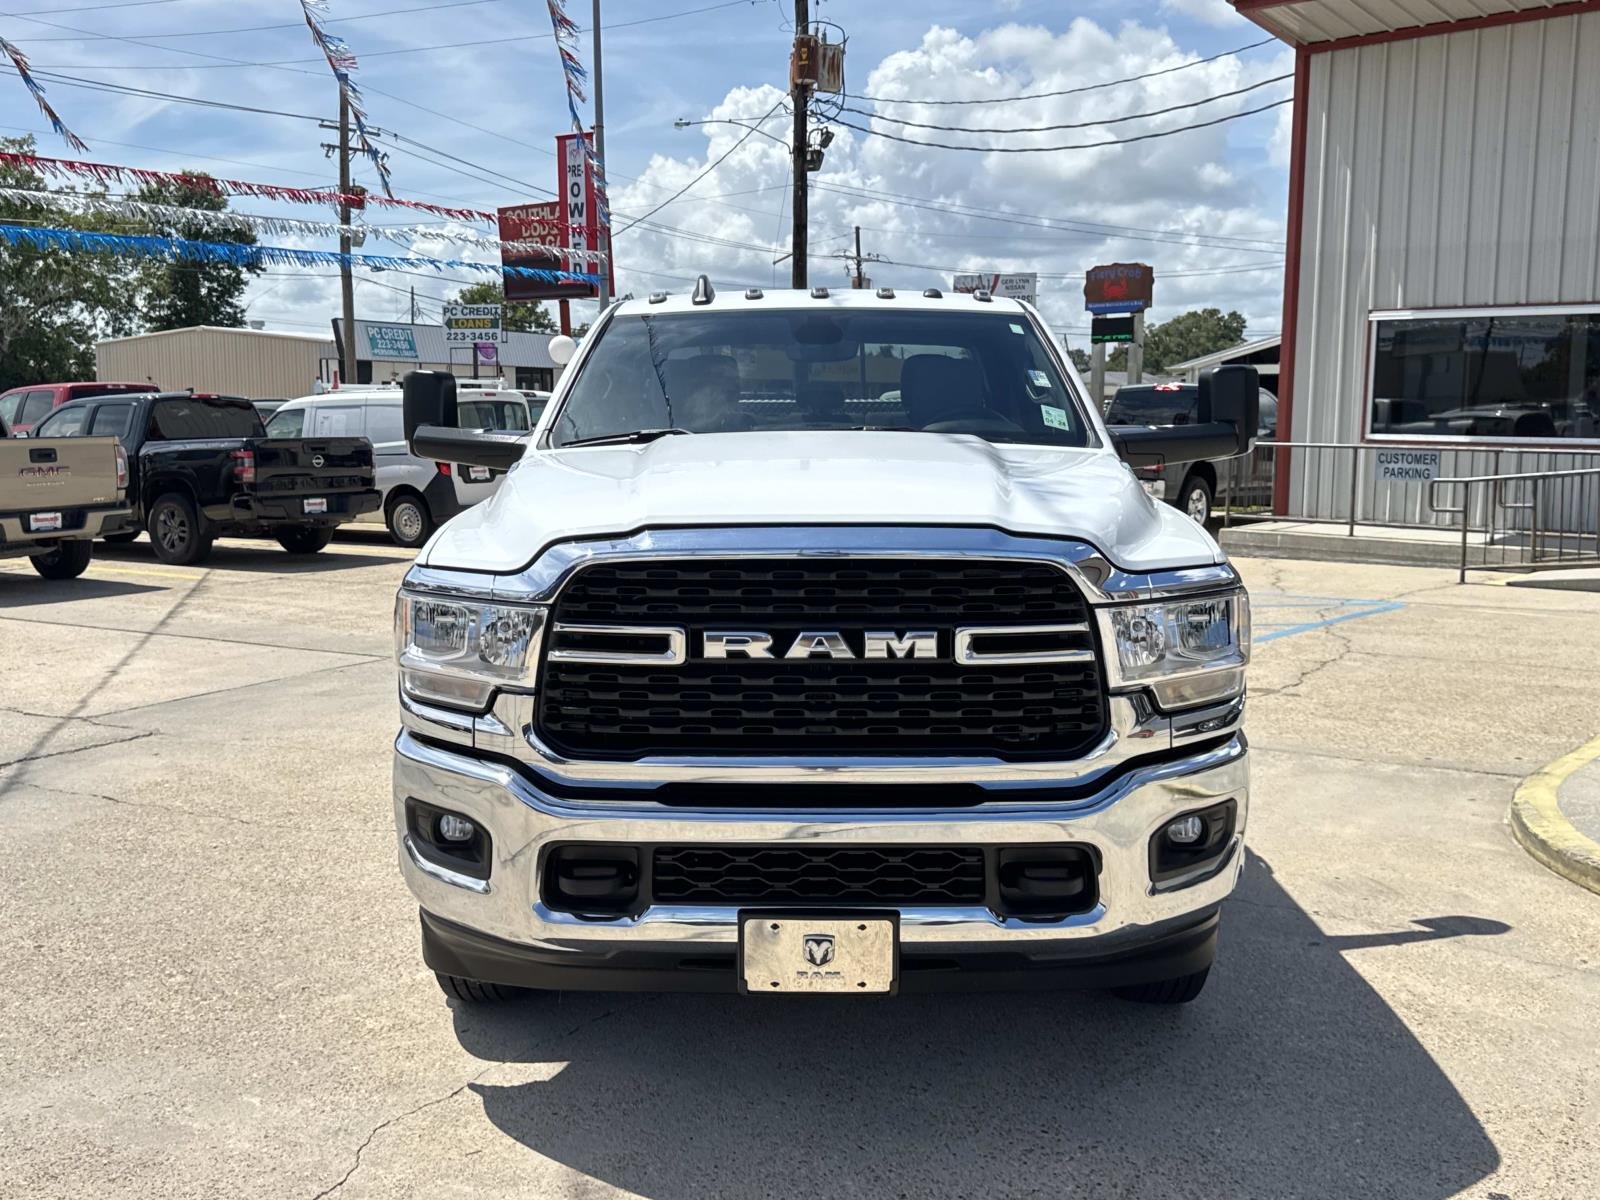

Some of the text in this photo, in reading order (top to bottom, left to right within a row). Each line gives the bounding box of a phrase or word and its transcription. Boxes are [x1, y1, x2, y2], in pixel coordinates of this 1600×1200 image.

[443, 306, 500, 317] PC CREDIT
[452, 319, 491, 329] LOANS
[367, 326, 413, 341] PC CREDIT
[446, 332, 498, 341] 223-3456
[1378, 452, 1438, 466] CUSTOMER
[1383, 466, 1431, 480] PARKING
[703, 631, 938, 659] RAM
